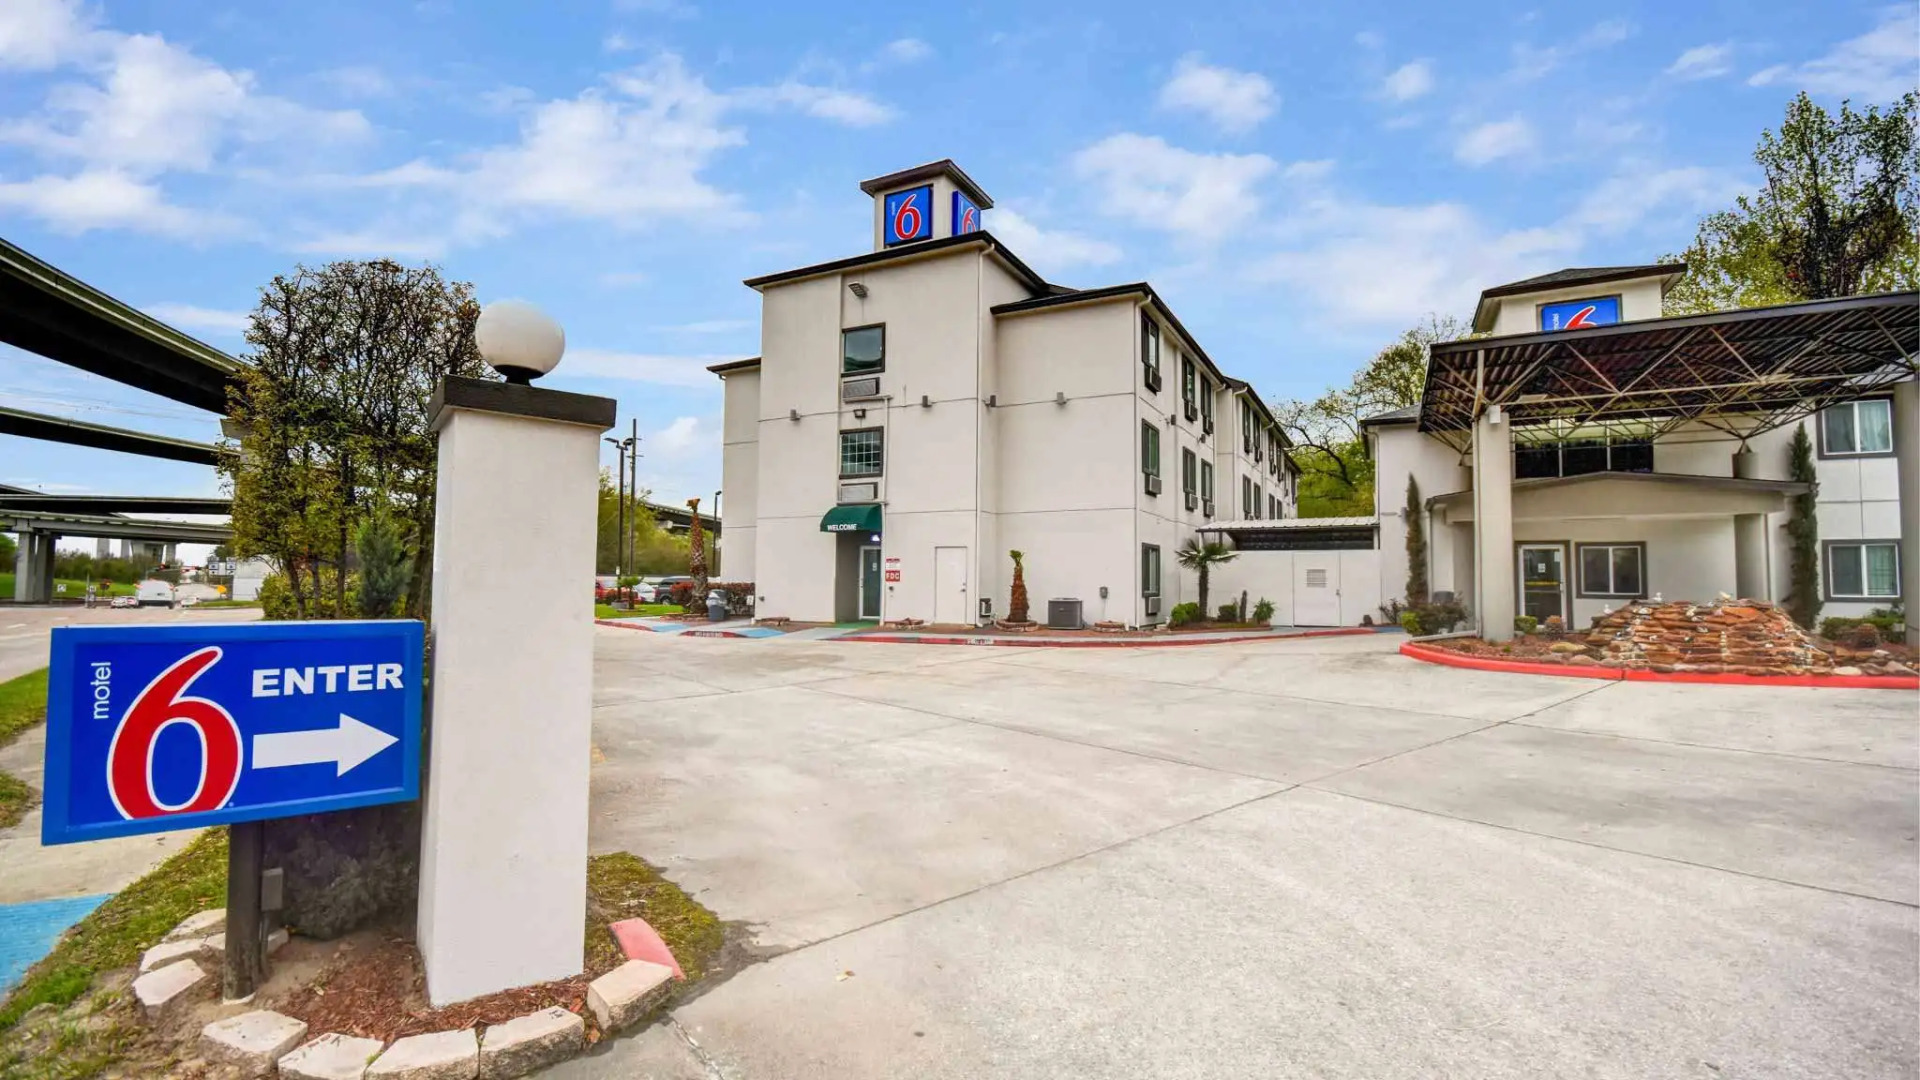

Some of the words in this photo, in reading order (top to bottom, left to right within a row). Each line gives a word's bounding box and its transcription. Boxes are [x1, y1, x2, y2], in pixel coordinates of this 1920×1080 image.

[894, 194, 921, 240] 6
[252, 663, 404, 697] ENTER
[90, 661, 111, 719] motel
[106, 645, 243, 820] 6
